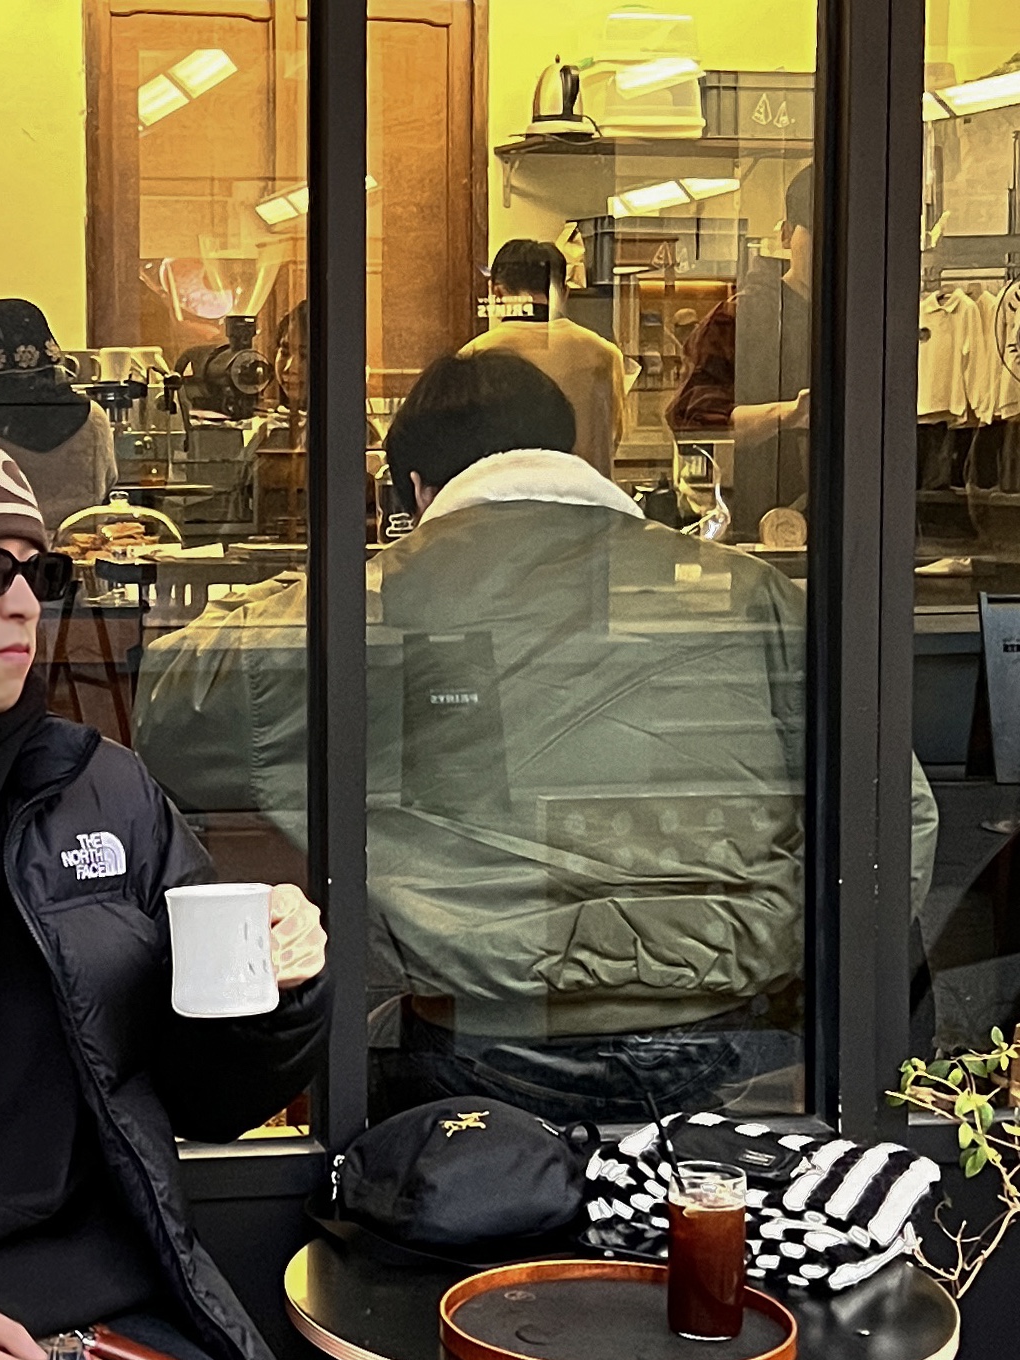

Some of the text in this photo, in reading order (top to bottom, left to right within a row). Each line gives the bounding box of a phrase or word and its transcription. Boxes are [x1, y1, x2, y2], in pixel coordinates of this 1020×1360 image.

[76, 833, 102, 850] THE
[60, 848, 104, 868] NORTH
[76, 863, 107, 880] FACE
